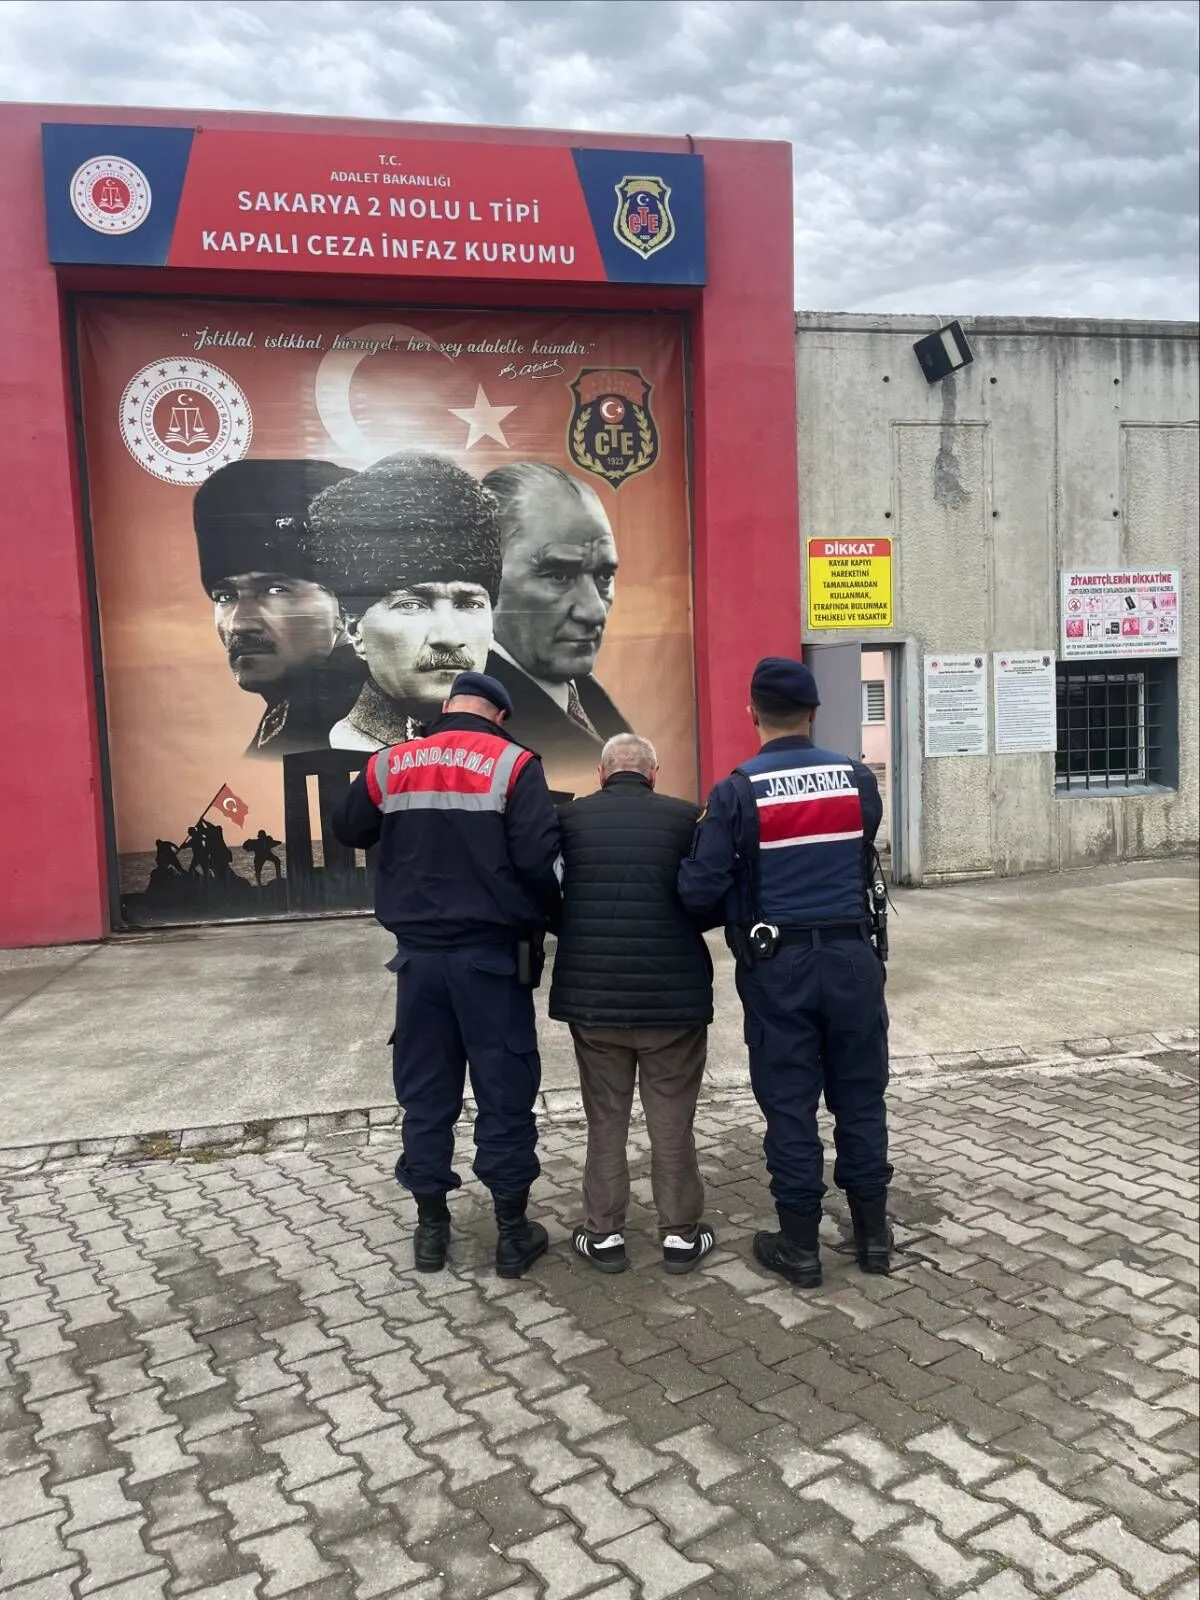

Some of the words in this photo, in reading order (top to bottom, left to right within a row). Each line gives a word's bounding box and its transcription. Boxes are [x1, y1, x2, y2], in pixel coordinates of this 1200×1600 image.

[378, 155, 401, 166] T.C.
[330, 171, 378, 184] ADALET
[383, 173, 451, 187] BAKANLIĞI
[238, 190, 360, 216] SAKARYA
[367, 197, 381, 217] 2
[390, 197, 460, 220] NOLU
[469, 201, 482, 221] L
[489, 198, 540, 223] TİPİ
[628, 206, 659, 233] CTE
[202, 230, 298, 254] KAPALI
[307, 234, 375, 257] CEZA
[382, 232, 457, 260] İNFAZ
[465, 241, 575, 265] KURUMU
[407, 335, 432, 351] her
[195, 384, 224, 410] ADALET
[595, 424, 634, 456] CTE
[824, 541, 875, 555] DİKKAT
[1070, 573, 1131, 587] ZİYARETÇİLERİN
[1132, 572, 1172, 584] DİKKATİNE
[390, 746, 496, 777] JANDARMA
[765, 770, 852, 797] JANDARMA
